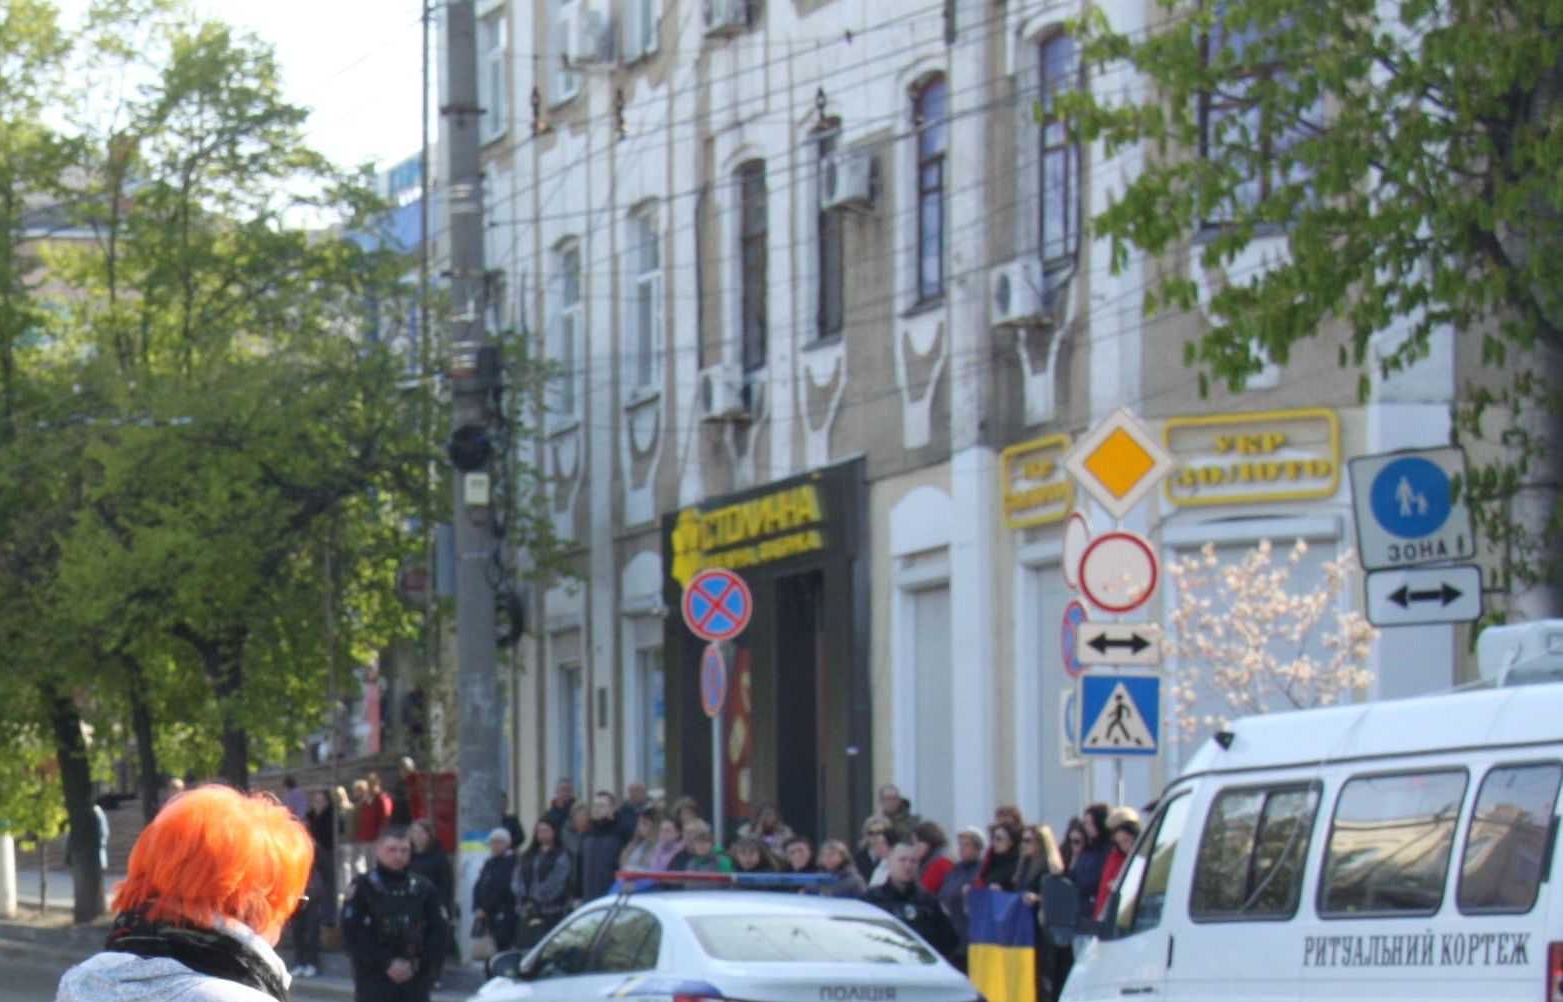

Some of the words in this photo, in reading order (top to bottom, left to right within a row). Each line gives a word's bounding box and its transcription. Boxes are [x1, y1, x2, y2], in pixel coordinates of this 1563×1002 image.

[1388, 541, 1448, 562] ЗОНА
[1303, 929, 1435, 967] РИТУАЛЬНИЙ
[1439, 932, 1532, 966] КОРТЕЖ
